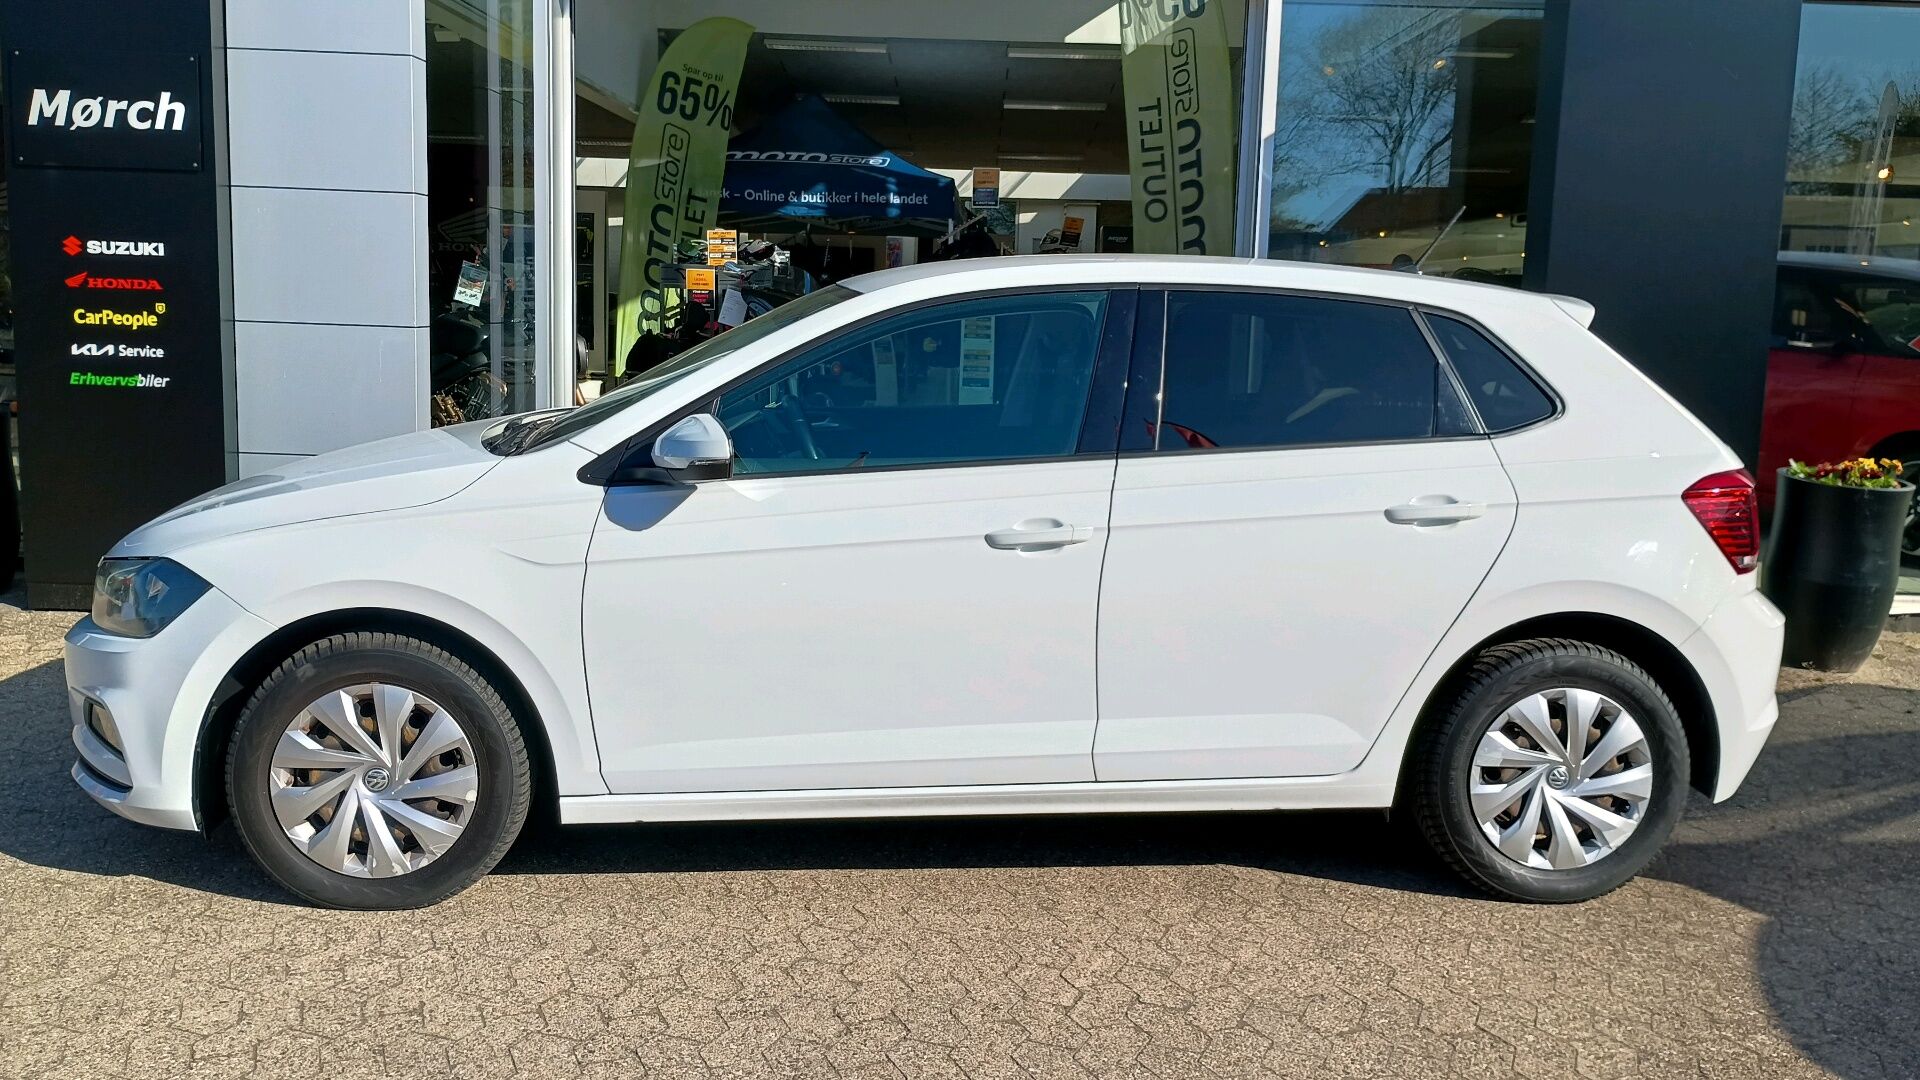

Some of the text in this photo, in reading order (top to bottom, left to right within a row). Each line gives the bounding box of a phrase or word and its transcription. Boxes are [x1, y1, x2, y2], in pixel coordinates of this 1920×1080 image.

[682, 63, 724, 82] Spar op til
[27, 88, 186, 131] Mørch
[656, 70, 733, 132] 65%
[744, 189, 785, 202] Online
[788, 191, 798, 202] &
[801, 191, 852, 203] butikker
[861, 192, 887, 204] hele
[890, 193, 929, 205] landet
[681, 187, 708, 251] LET
[86, 240, 165, 256] SUZUKI
[87, 278, 164, 290] HONDA
[73, 308, 158, 330] CarPeople
[71, 343, 165, 358] KIA Service
[70, 372, 171, 388] Erhvervsbiler
